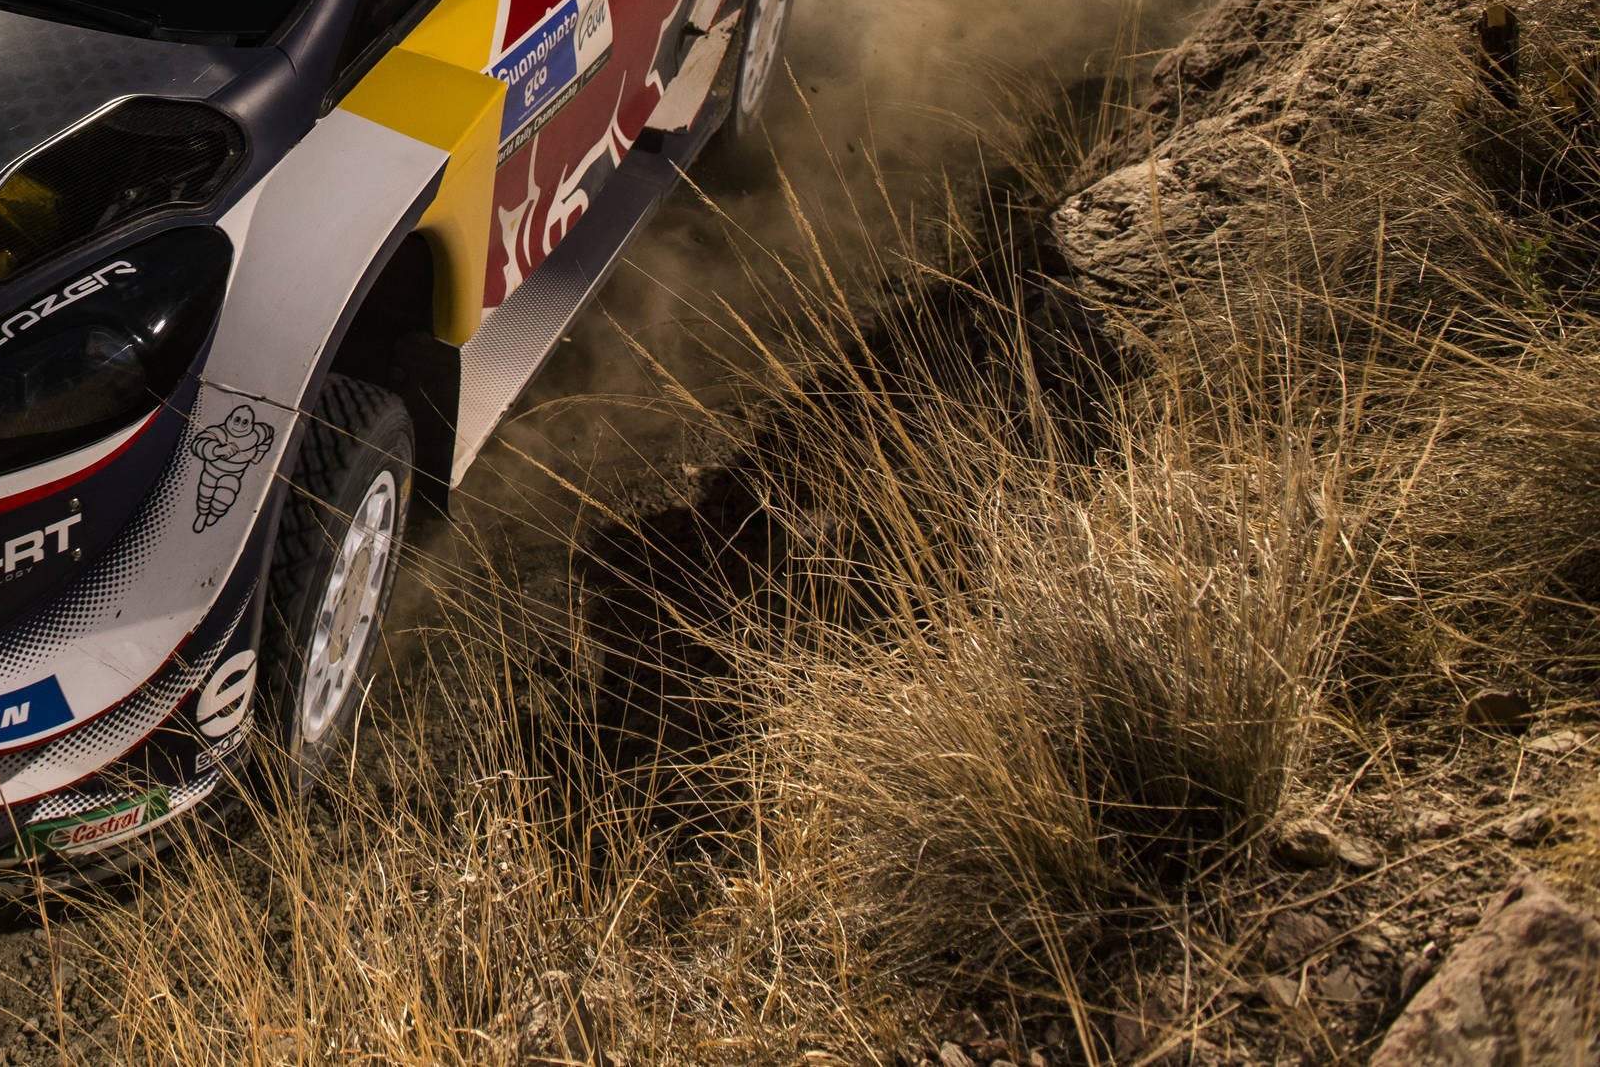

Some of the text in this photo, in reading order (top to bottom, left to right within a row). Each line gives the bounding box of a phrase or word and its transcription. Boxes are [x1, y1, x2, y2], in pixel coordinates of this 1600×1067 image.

[497, 11, 579, 86] Guanajuato
[523, 65, 549, 108] gto
[514, 124, 534, 150] Rally
[533, 82, 579, 130] Championship
[71, 806, 141, 843] Castrol
